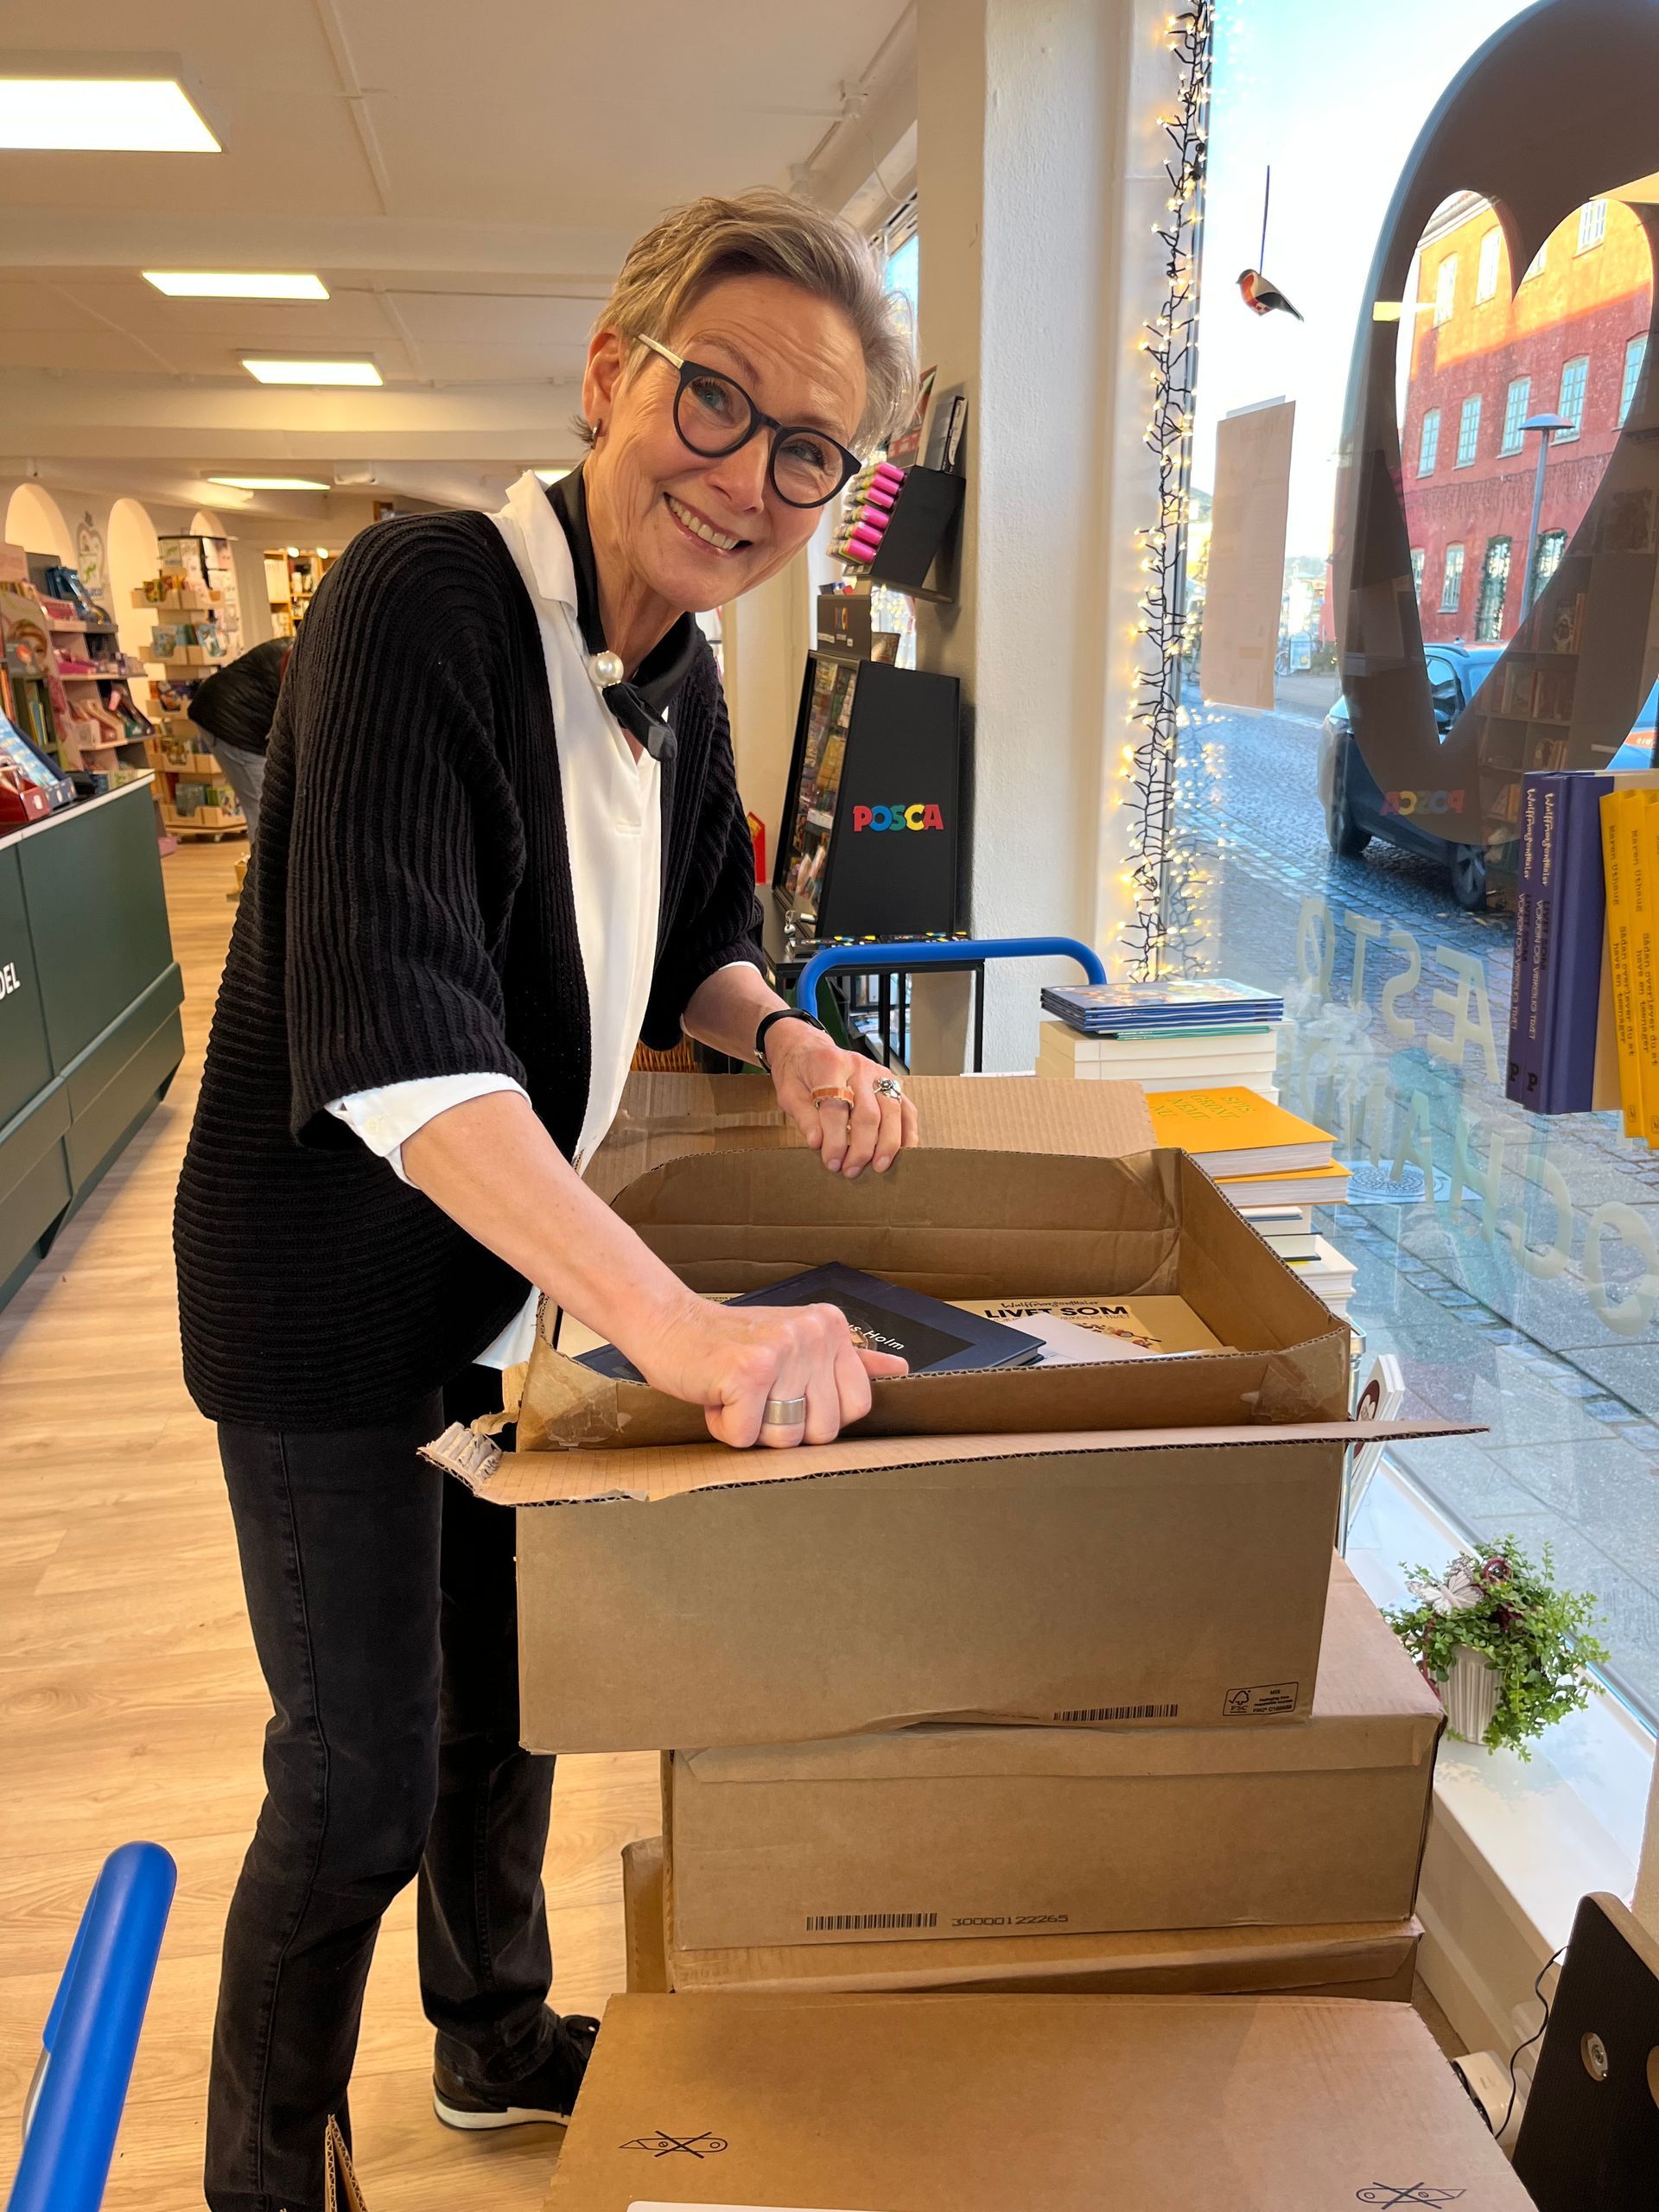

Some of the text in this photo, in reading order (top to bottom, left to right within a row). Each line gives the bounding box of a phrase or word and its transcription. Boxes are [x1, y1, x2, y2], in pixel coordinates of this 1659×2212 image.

[853, 804, 944, 832] POSCA
[1060, 1306, 1128, 1316] SOM
[862, 1330, 905, 1351] Holm
[951, 1914, 1069, 1927] 30000122265
